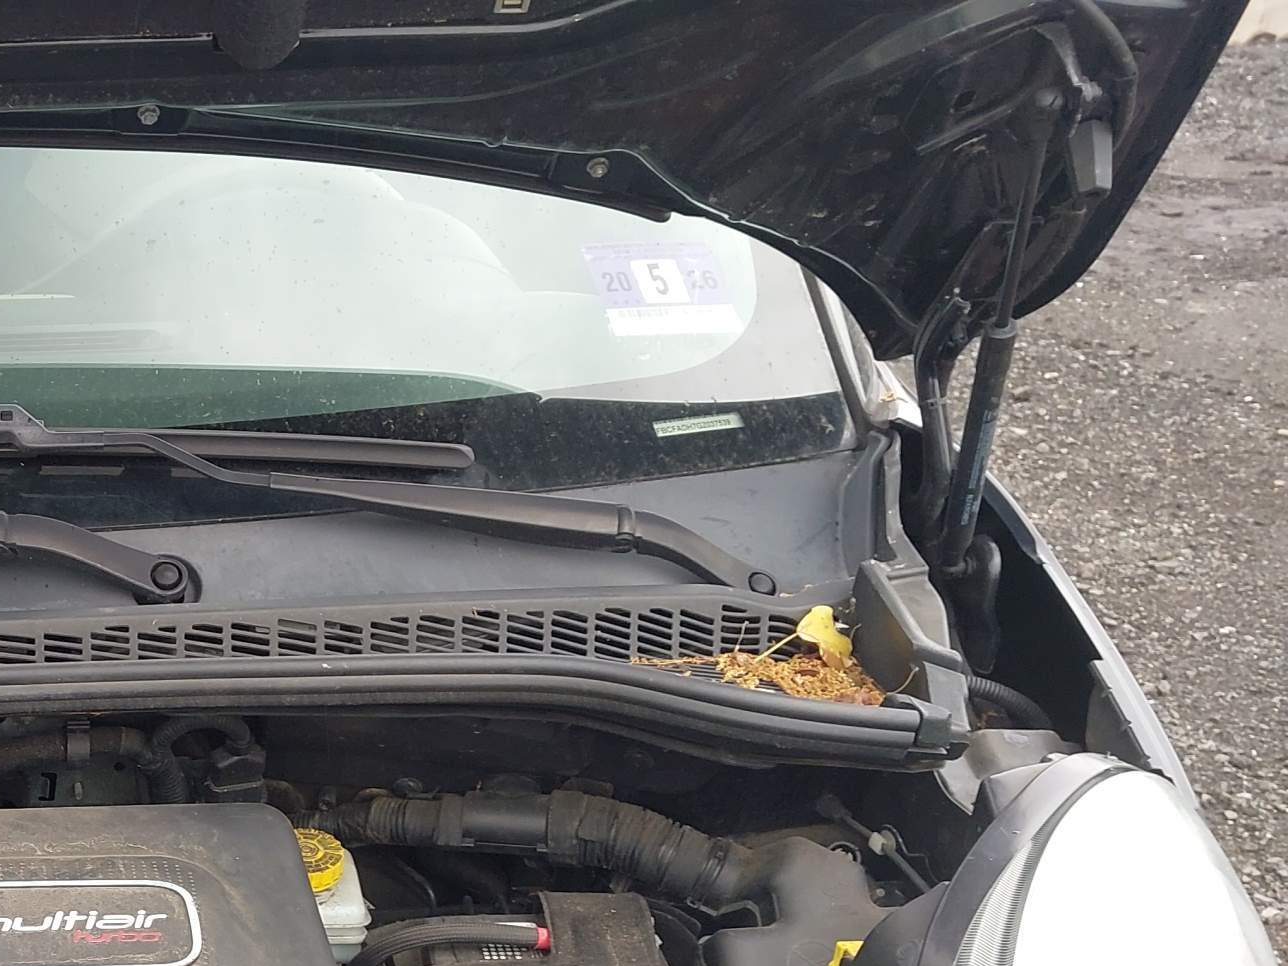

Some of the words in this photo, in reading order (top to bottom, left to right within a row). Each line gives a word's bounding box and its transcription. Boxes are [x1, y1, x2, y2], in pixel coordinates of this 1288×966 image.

[602, 271, 632, 292] 20
[646, 262, 669, 296] 5
[72, 929, 162, 944] turbo
